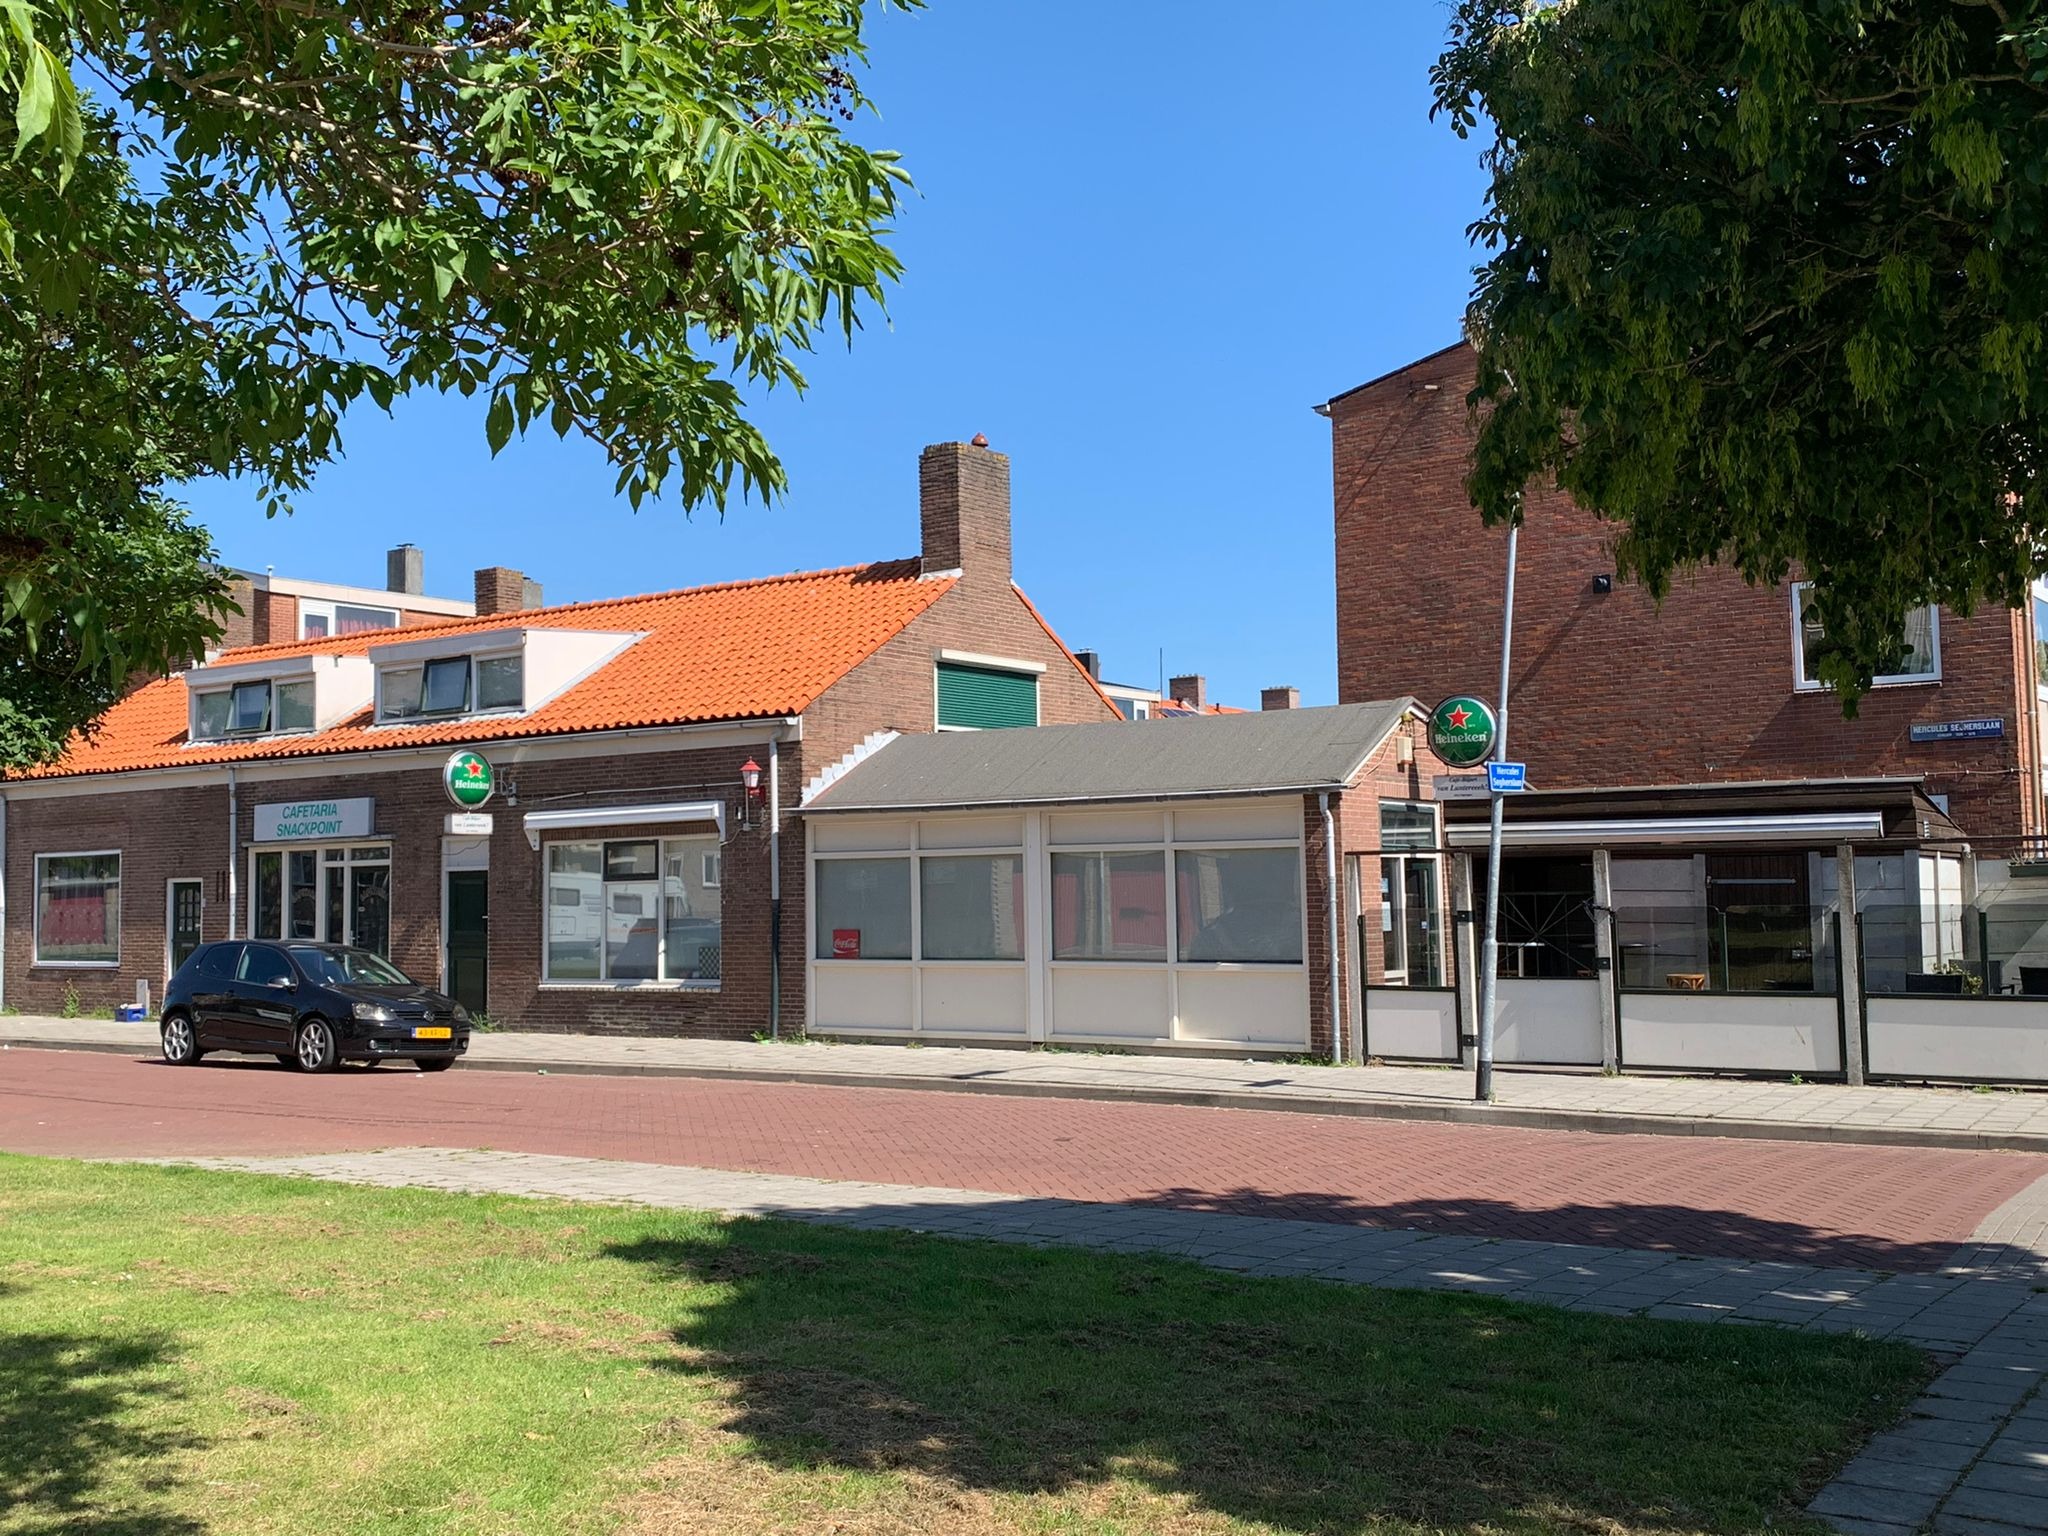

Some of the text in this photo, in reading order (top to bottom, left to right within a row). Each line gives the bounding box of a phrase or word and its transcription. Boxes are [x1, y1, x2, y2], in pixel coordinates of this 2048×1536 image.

[1913, 724, 1948, 733] HERCULES
[1435, 732, 1487, 744] Heineken
[1496, 767, 1520, 776] Hercules
[282, 803, 338, 819] CAFETARIA
[276, 820, 343, 837] SNACKPOINT
